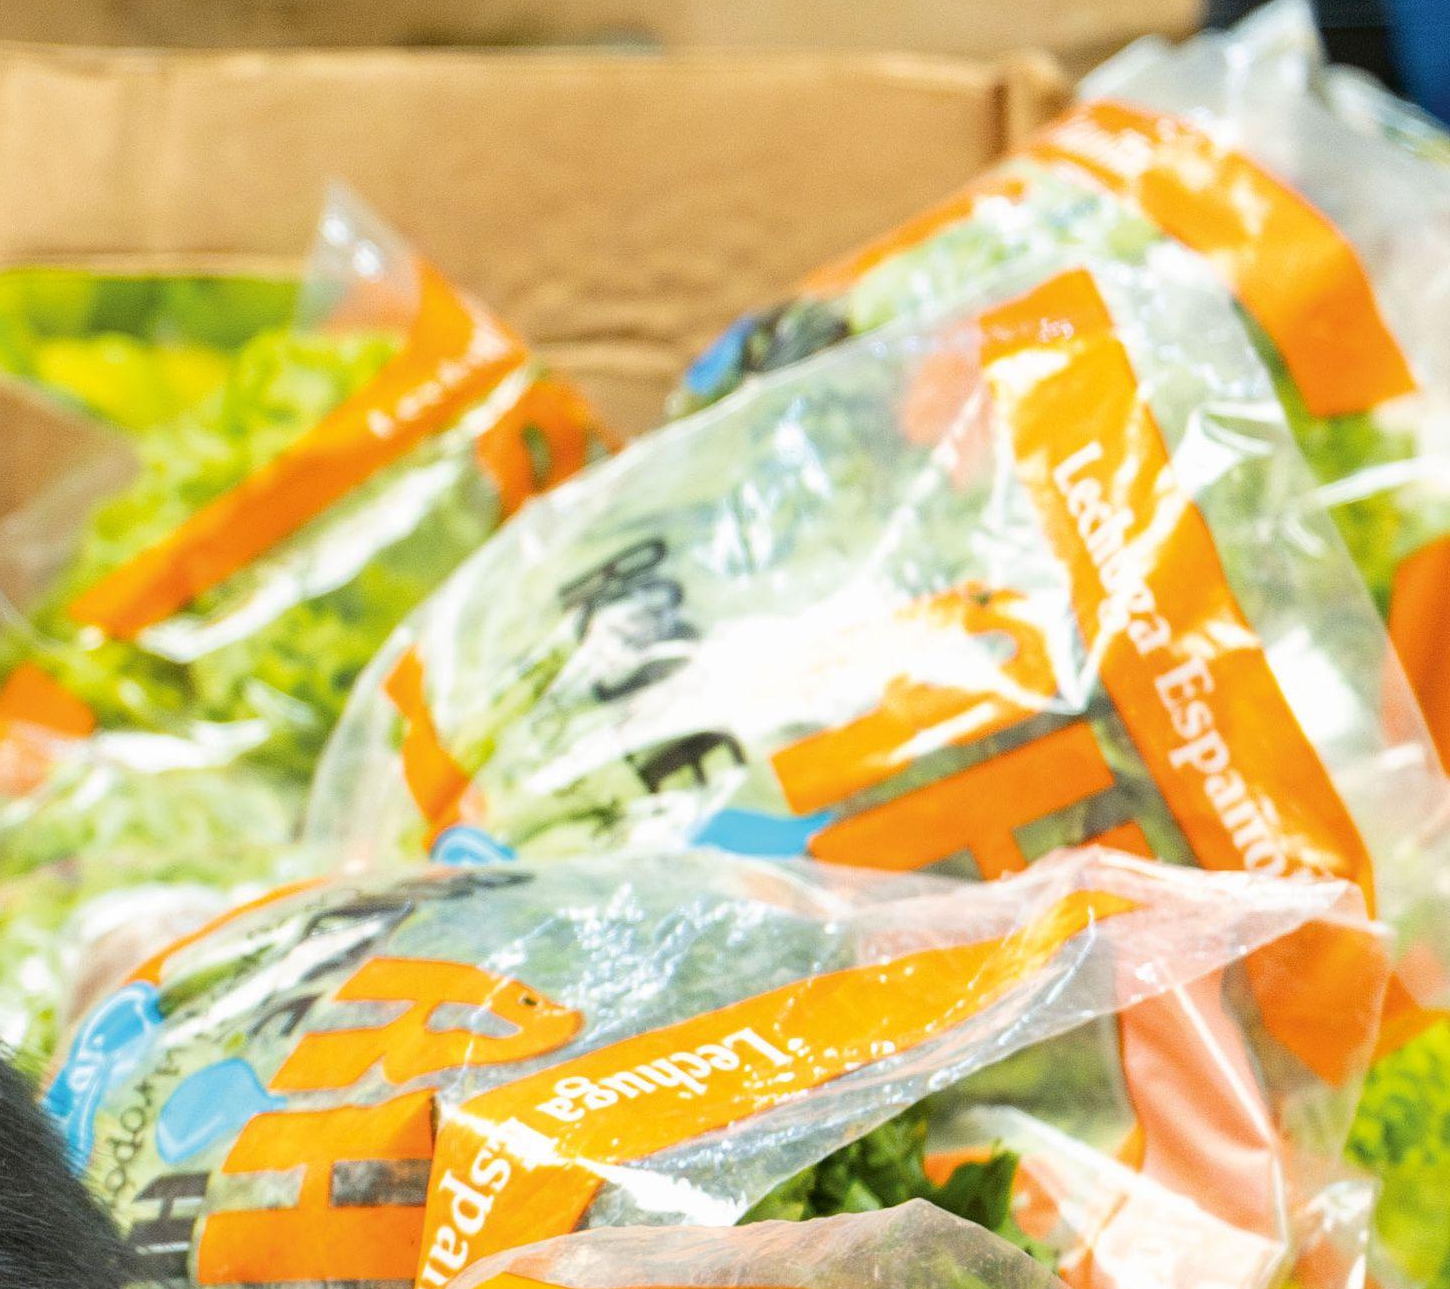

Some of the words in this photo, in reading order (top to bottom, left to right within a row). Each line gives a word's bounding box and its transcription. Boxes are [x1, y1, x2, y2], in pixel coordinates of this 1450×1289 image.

[1050, 439, 1172, 656] Lechuga
[1154, 654, 1322, 887] Españo
[534, 1025, 796, 1123] Lechuga
